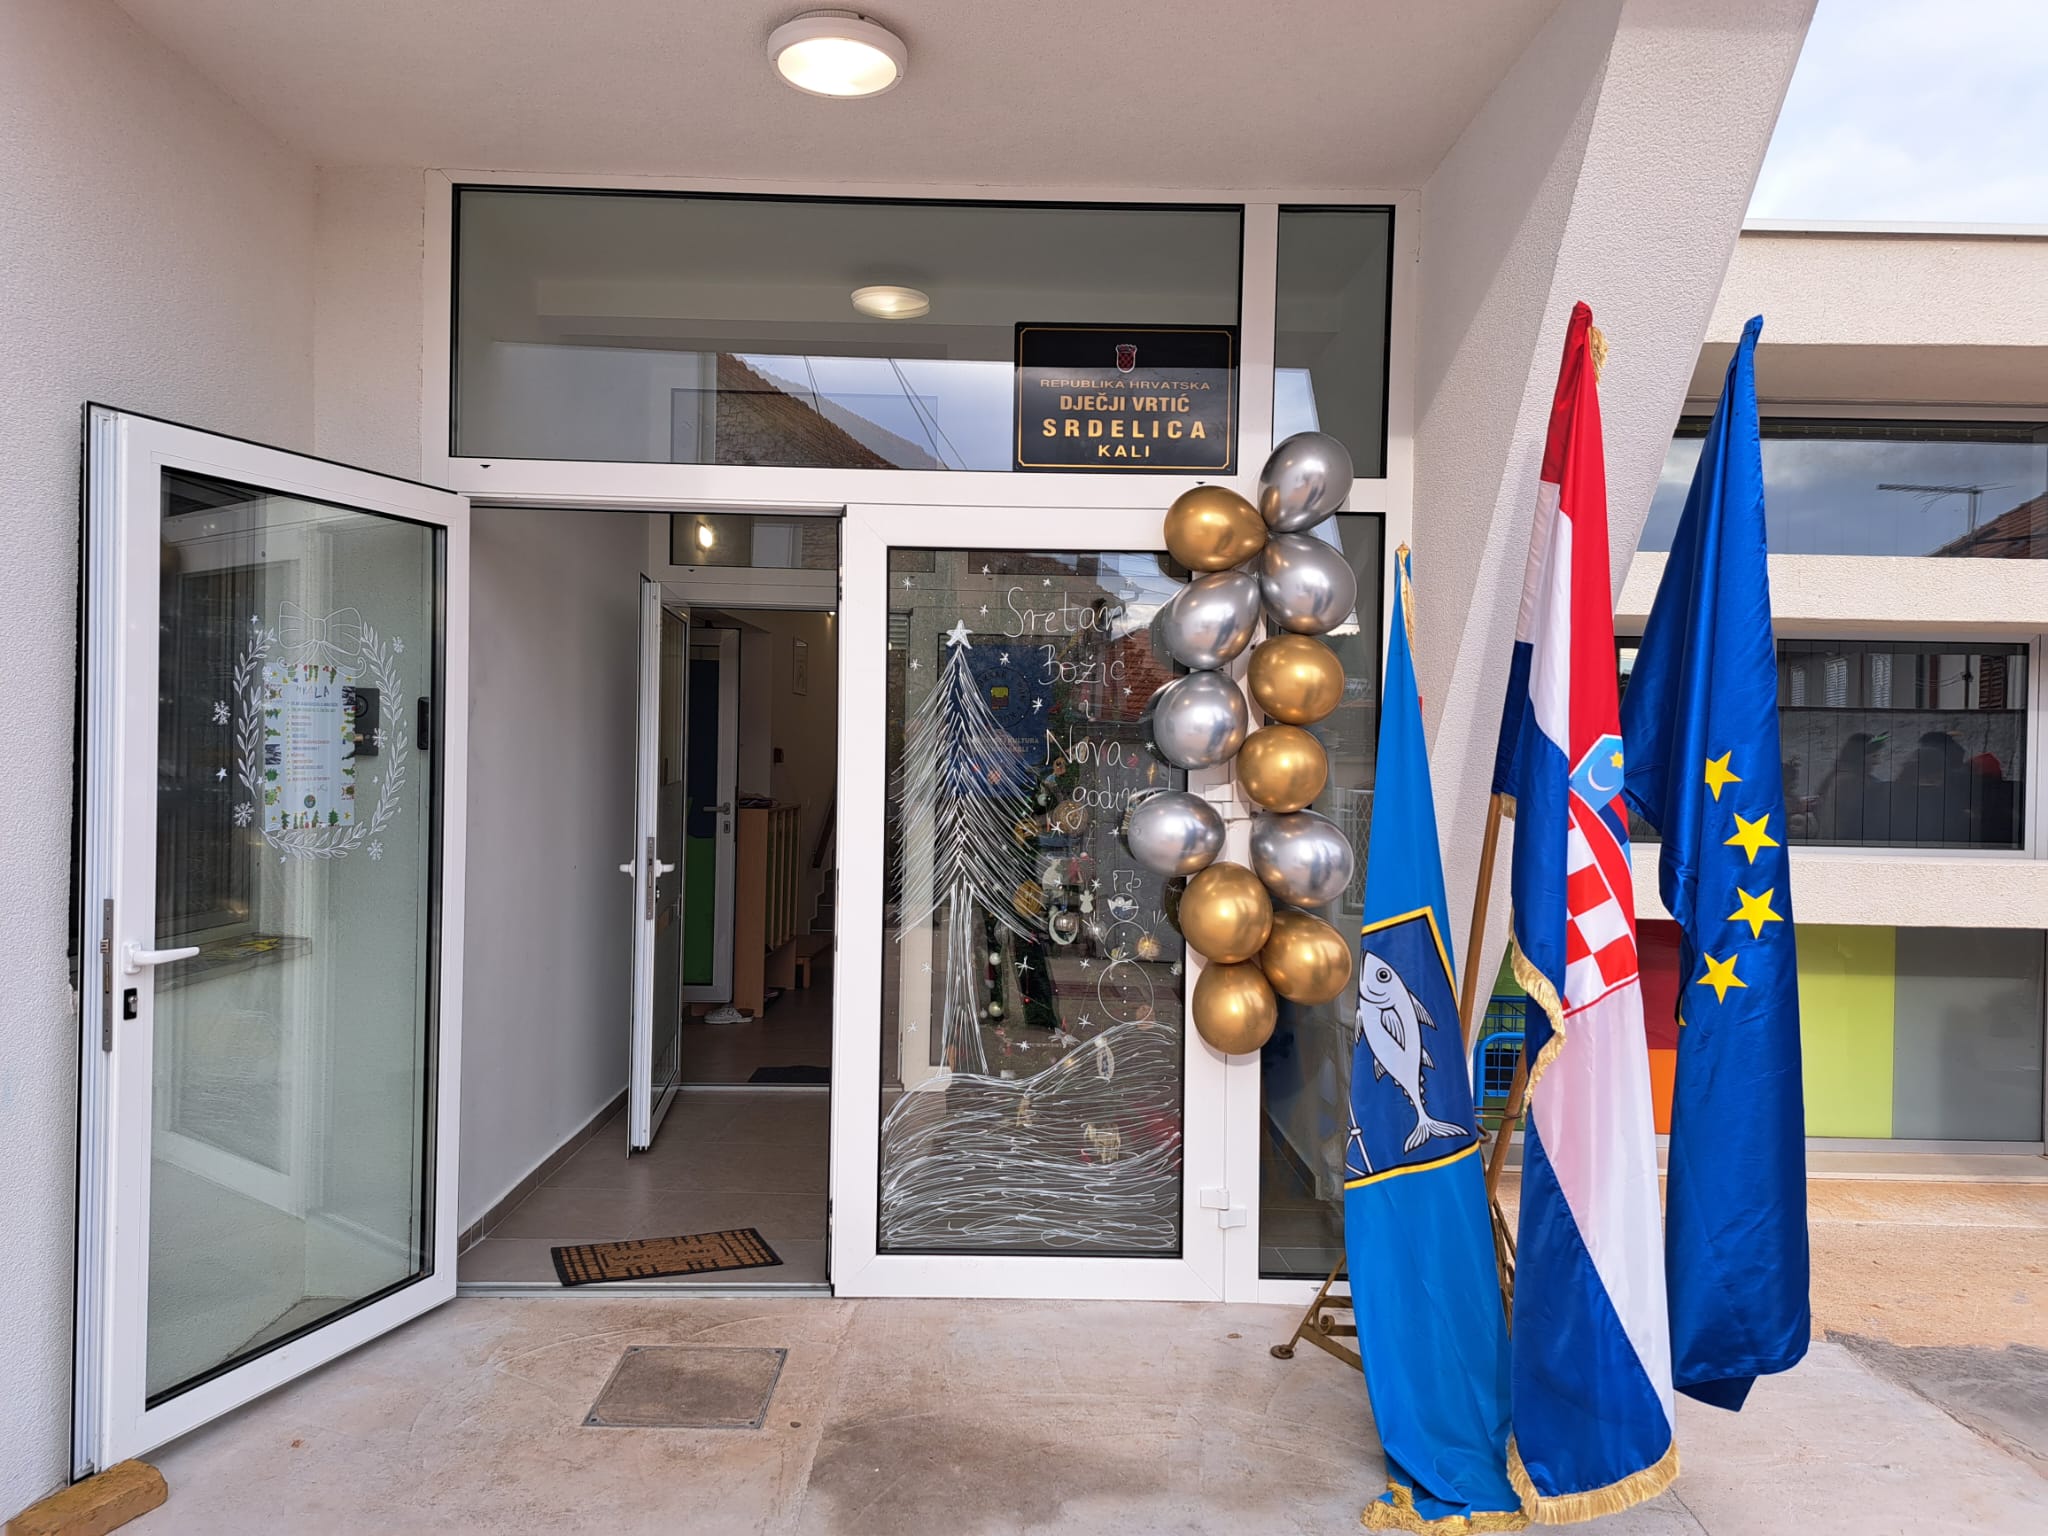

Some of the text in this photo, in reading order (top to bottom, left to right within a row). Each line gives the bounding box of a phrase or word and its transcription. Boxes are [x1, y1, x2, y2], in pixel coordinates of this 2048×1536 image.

[1040, 379, 1210, 390] REPUBLIKA HRVATSKA
[1059, 392, 1191, 413] DJEČJI VRTIĆ
[1042, 418, 1207, 439] SRDELICA
[1097, 444, 1150, 458] KALI
[1003, 586, 1136, 640] Sretan
[1045, 726, 1132, 769] Nova
[1066, 775, 1157, 830] godin
